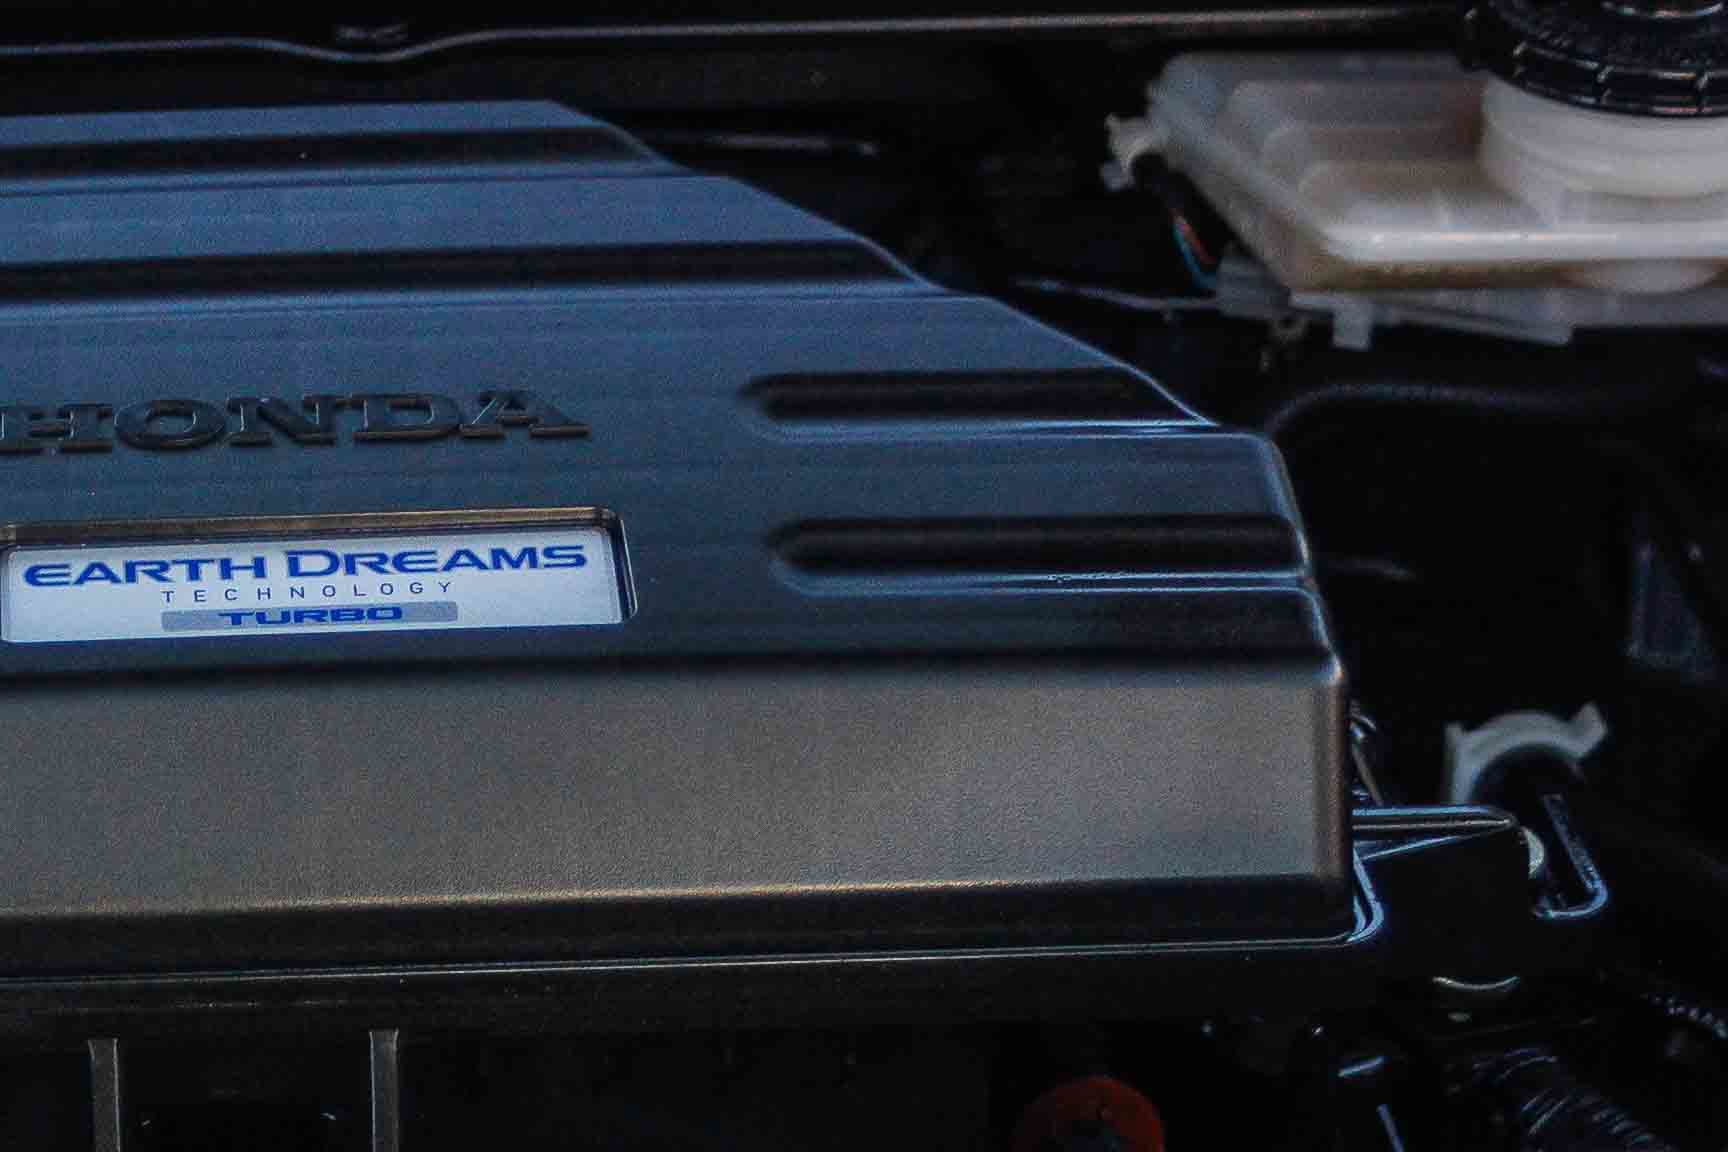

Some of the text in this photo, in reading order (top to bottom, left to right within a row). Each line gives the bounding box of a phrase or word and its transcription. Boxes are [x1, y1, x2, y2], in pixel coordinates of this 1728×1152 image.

[24, 545, 588, 587] EARTH DREAMS
[161, 581, 452, 604] TECHNOLOGY
[217, 605, 403, 627] TURBO
